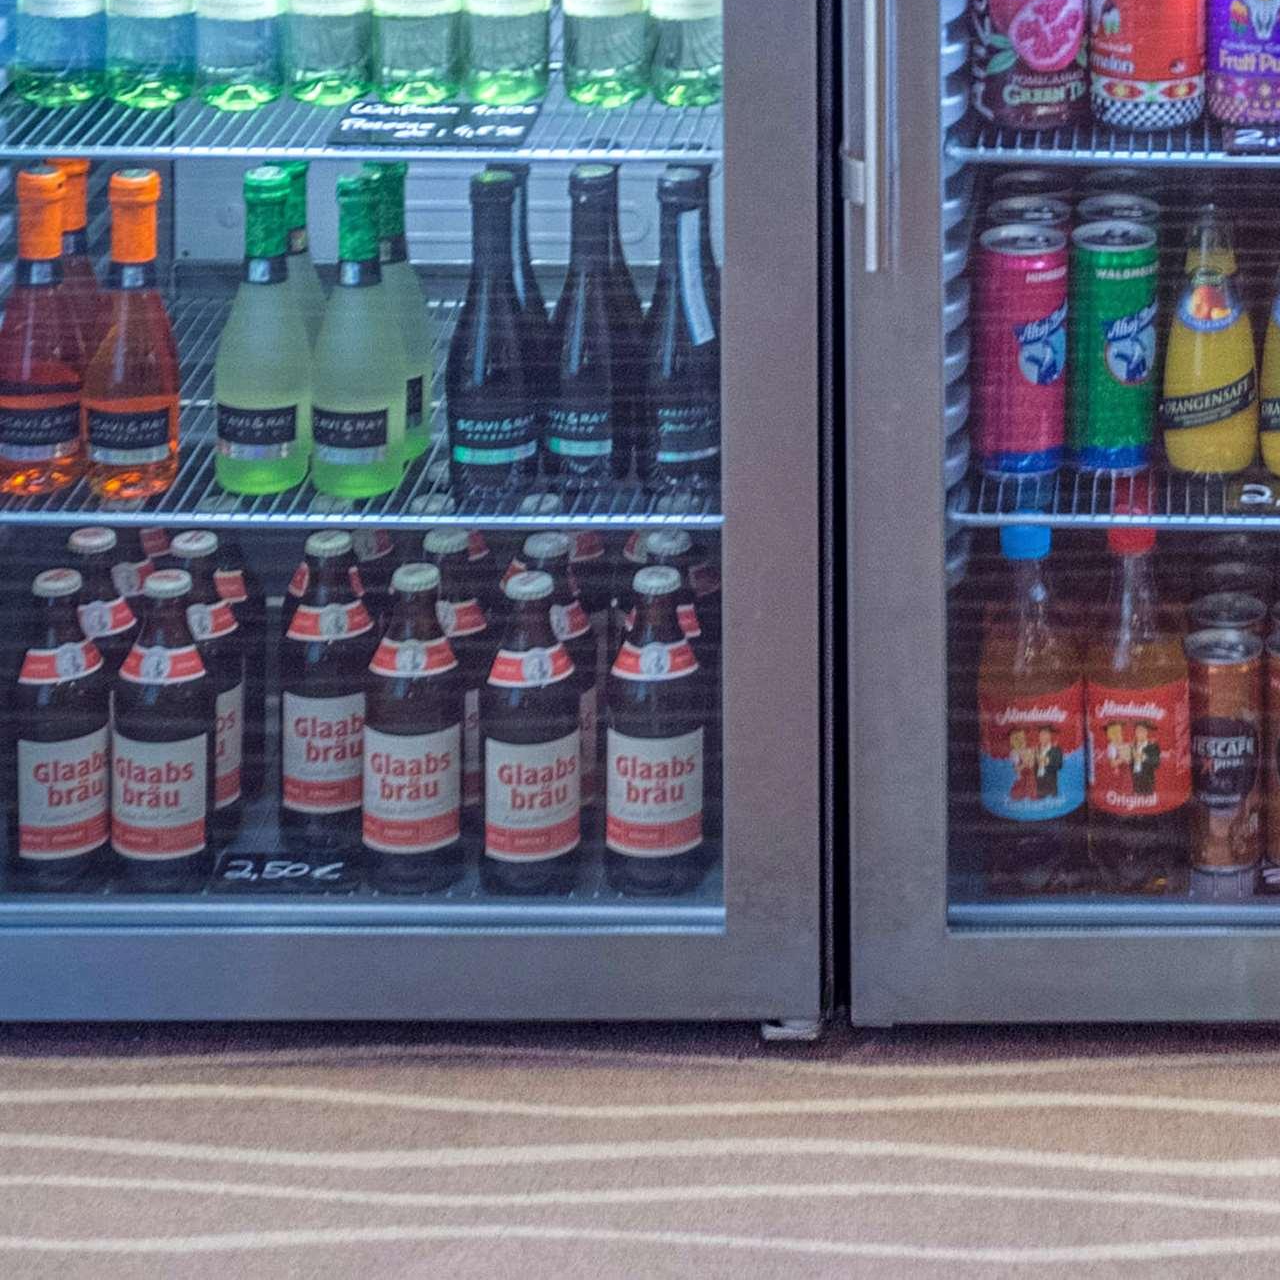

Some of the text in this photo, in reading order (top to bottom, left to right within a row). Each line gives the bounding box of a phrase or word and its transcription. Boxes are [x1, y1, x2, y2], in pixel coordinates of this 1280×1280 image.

[1164, 379, 1250, 414] ORANGENSAFT
[1096, 700, 1166, 721] Almdudler
[115, 759, 194, 784] Glaabs
[371, 753, 450, 777] Glaabs
[497, 754, 577, 786] Glaabs
[615, 754, 696, 780] Glaabs
[123, 787, 180, 808] bräu
[380, 777, 439, 802] bräu
[510, 784, 568, 811] bräu
[626, 780, 685, 804] bräu
[1106, 791, 1158, 809] Original
